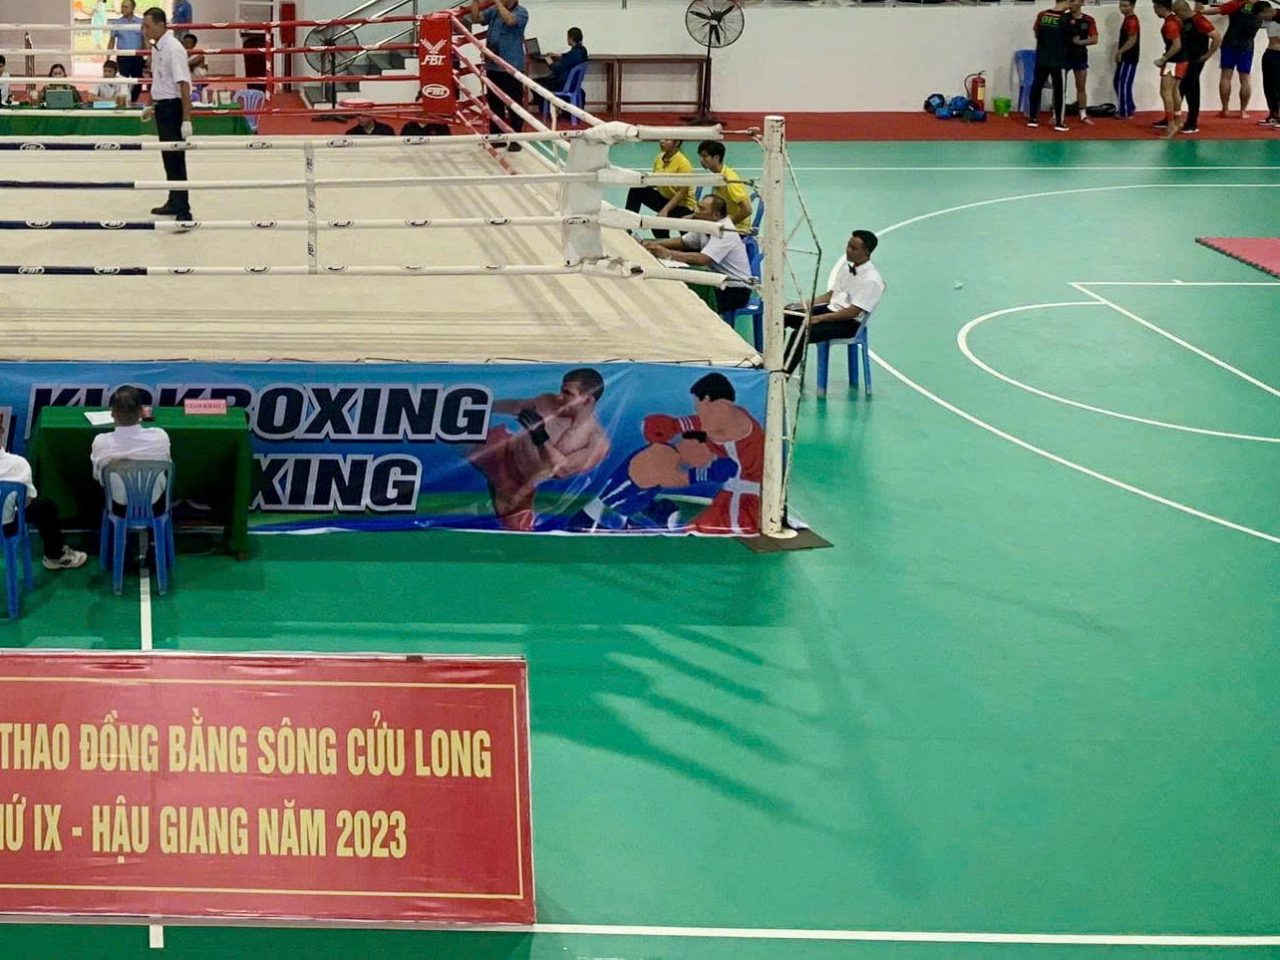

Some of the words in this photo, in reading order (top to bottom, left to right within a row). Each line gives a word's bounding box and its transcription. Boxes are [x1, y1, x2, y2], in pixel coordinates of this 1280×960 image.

[421, 55, 446, 65] FBT
[79, 710, 159, 772] ĐỒNG
[169, 707, 248, 774] BẰNG
[257, 717, 337, 776] SÔNG
[346, 710, 405, 777] CỬU
[415, 729, 492, 778] LONG
[34, 804, 63, 852] IX
[92, 795, 150, 864] HẬU
[159, 806, 249, 856] GIANG
[258, 799, 326, 857] NĂM
[336, 810, 408, 858] 2023
